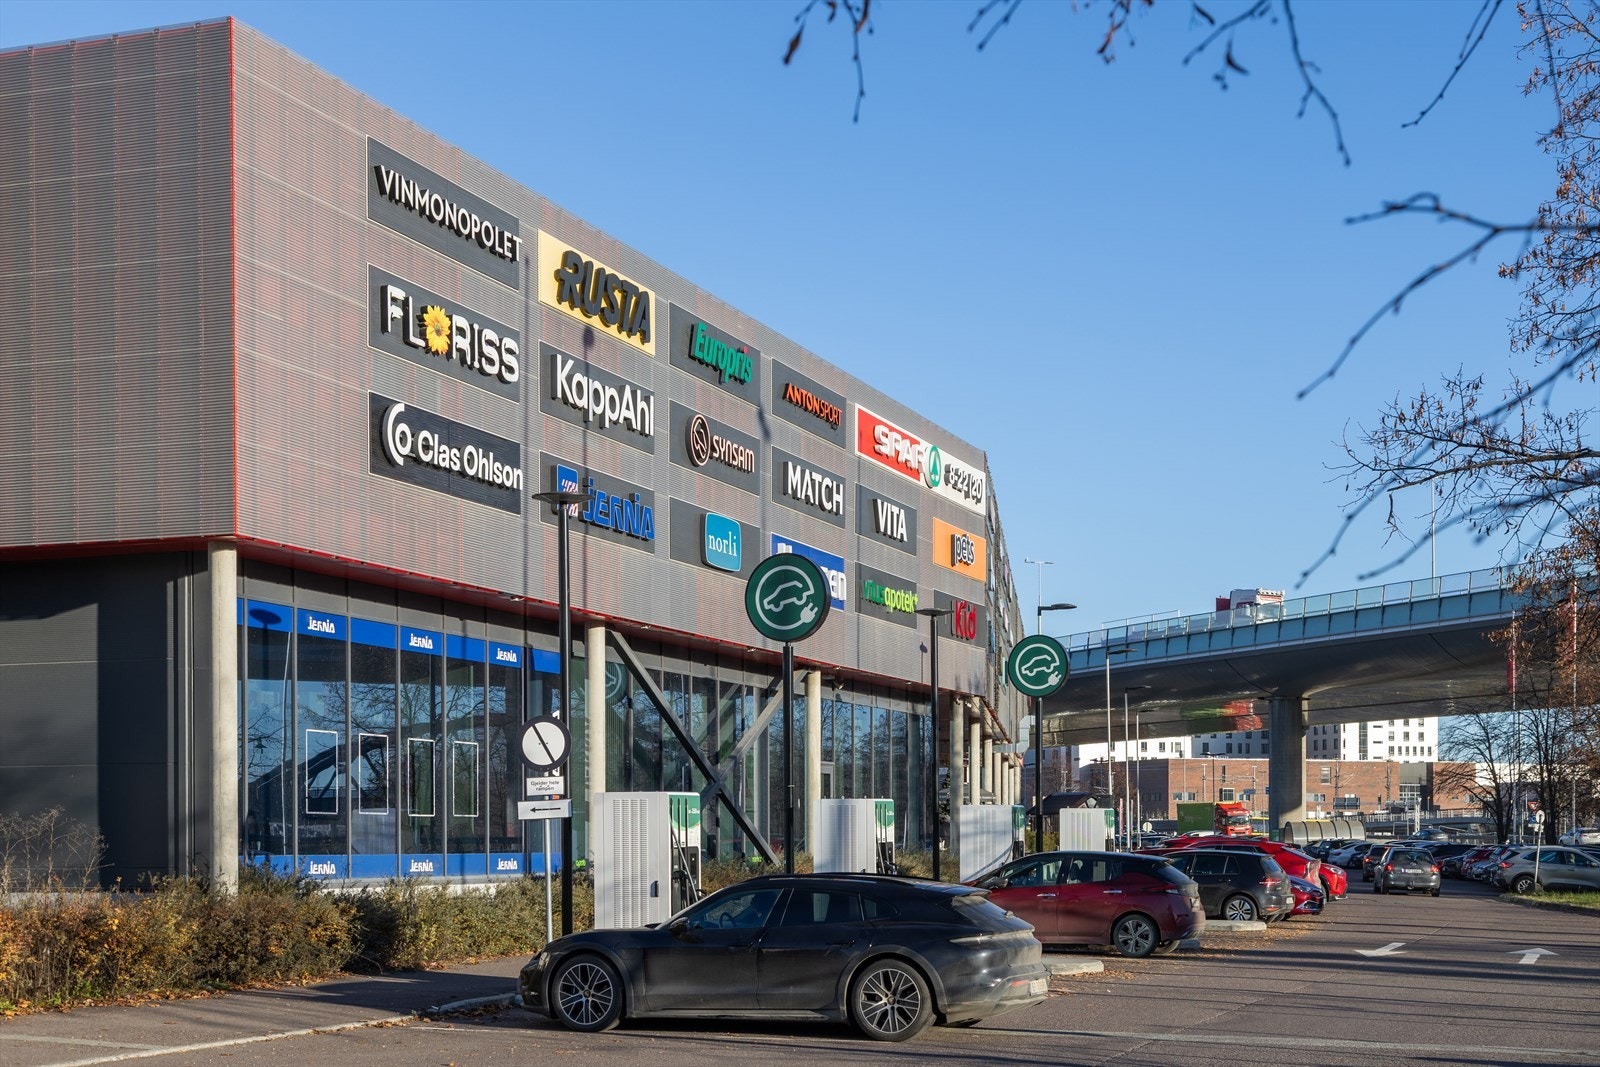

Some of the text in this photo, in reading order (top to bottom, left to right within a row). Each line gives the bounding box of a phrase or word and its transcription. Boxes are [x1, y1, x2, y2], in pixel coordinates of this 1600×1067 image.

[375, 165, 522, 262] VINMONOPOLET
[555, 250, 650, 343] RUSTA
[692, 322, 753, 384] Europris
[555, 354, 654, 436] KappAhl
[417, 430, 461, 472] Clas
[463, 445, 523, 490] Ohlson
[874, 424, 926, 474] SPAR
[787, 462, 843, 515] MATCH
[708, 530, 737, 557] norli
[875, 498, 907, 543] VITA
[954, 534, 975, 566] pets
[954, 600, 977, 640] Kid
